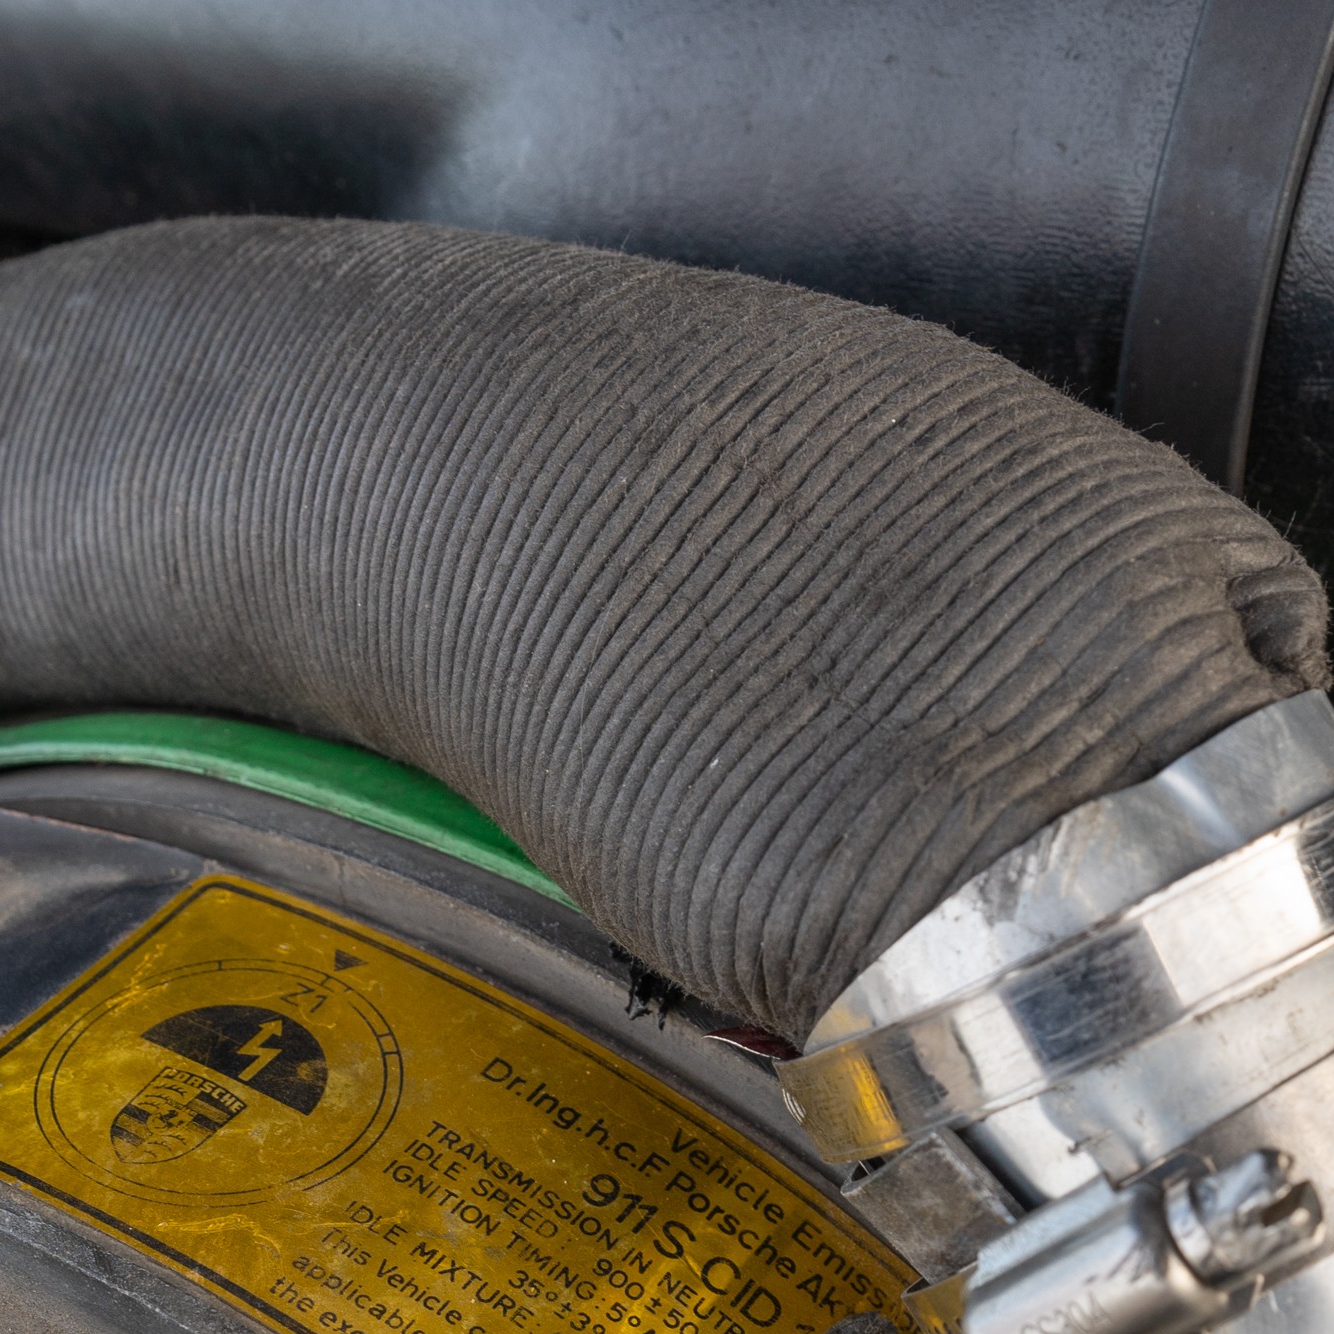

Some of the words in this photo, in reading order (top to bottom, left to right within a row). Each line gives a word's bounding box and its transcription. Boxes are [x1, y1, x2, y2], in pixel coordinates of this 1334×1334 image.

[279, 982, 328, 1014] Z1
[162, 1066, 244, 1114] PORSCHE
[382, 1159, 501, 1236] IGNITION
[403, 1138, 467, 1181] IDLE
[425, 1120, 618, 1250] TRANSMISSION
[622, 1247, 654, 1274] IN
[671, 1128, 785, 1224] Vehicle
[345, 1199, 408, 1246] IDLE
[581, 1173, 659, 1234] 911
[653, 1220, 697, 1259] S
[701, 1256, 782, 1328] CID
[665, 1171, 797, 1279] Porsche
[268, 1275, 315, 1313] the
[320, 1226, 373, 1266] This
[376, 1258, 463, 1325] Vehicle
